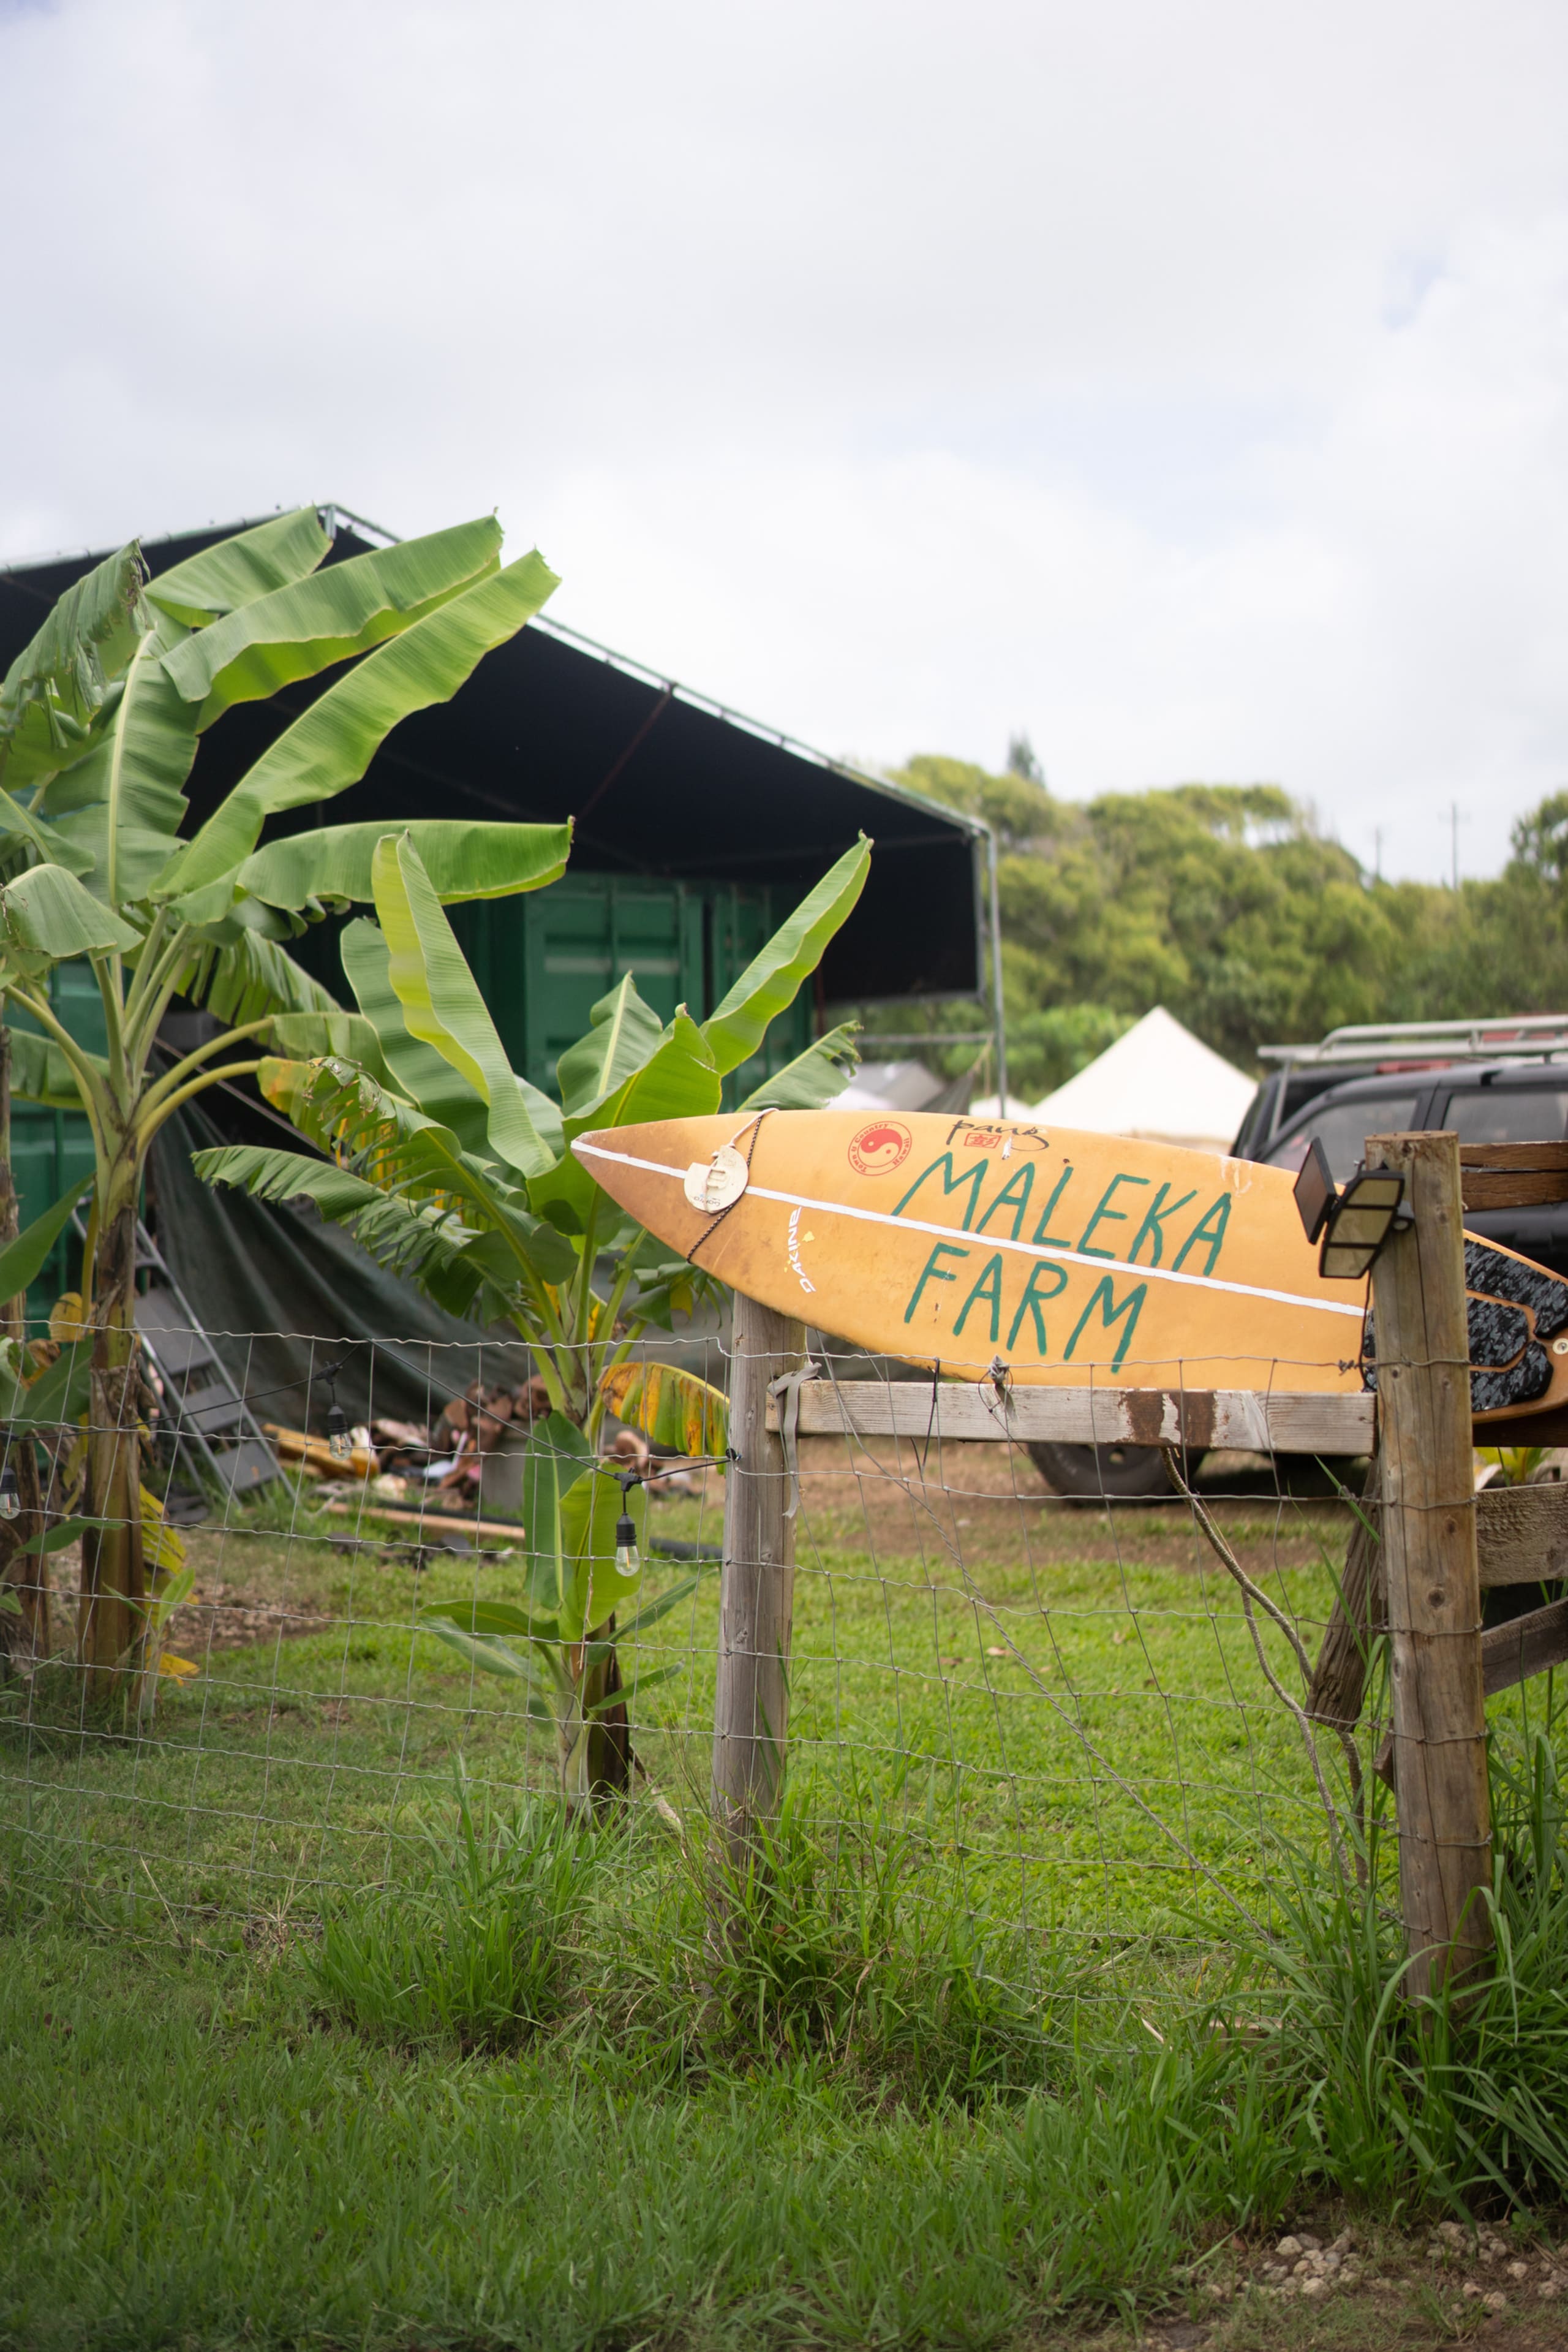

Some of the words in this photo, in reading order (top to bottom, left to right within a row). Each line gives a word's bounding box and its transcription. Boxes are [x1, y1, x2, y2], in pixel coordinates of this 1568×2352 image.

[854, 1124, 888, 1143] Country
[892, 1138, 910, 1165] Hawaii
[852, 1154, 867, 1173] Town
[891, 1152, 1231, 1276] MALEKA
[788, 1206, 816, 1293] DAKINE
[904, 1242, 1148, 1374] FARM
